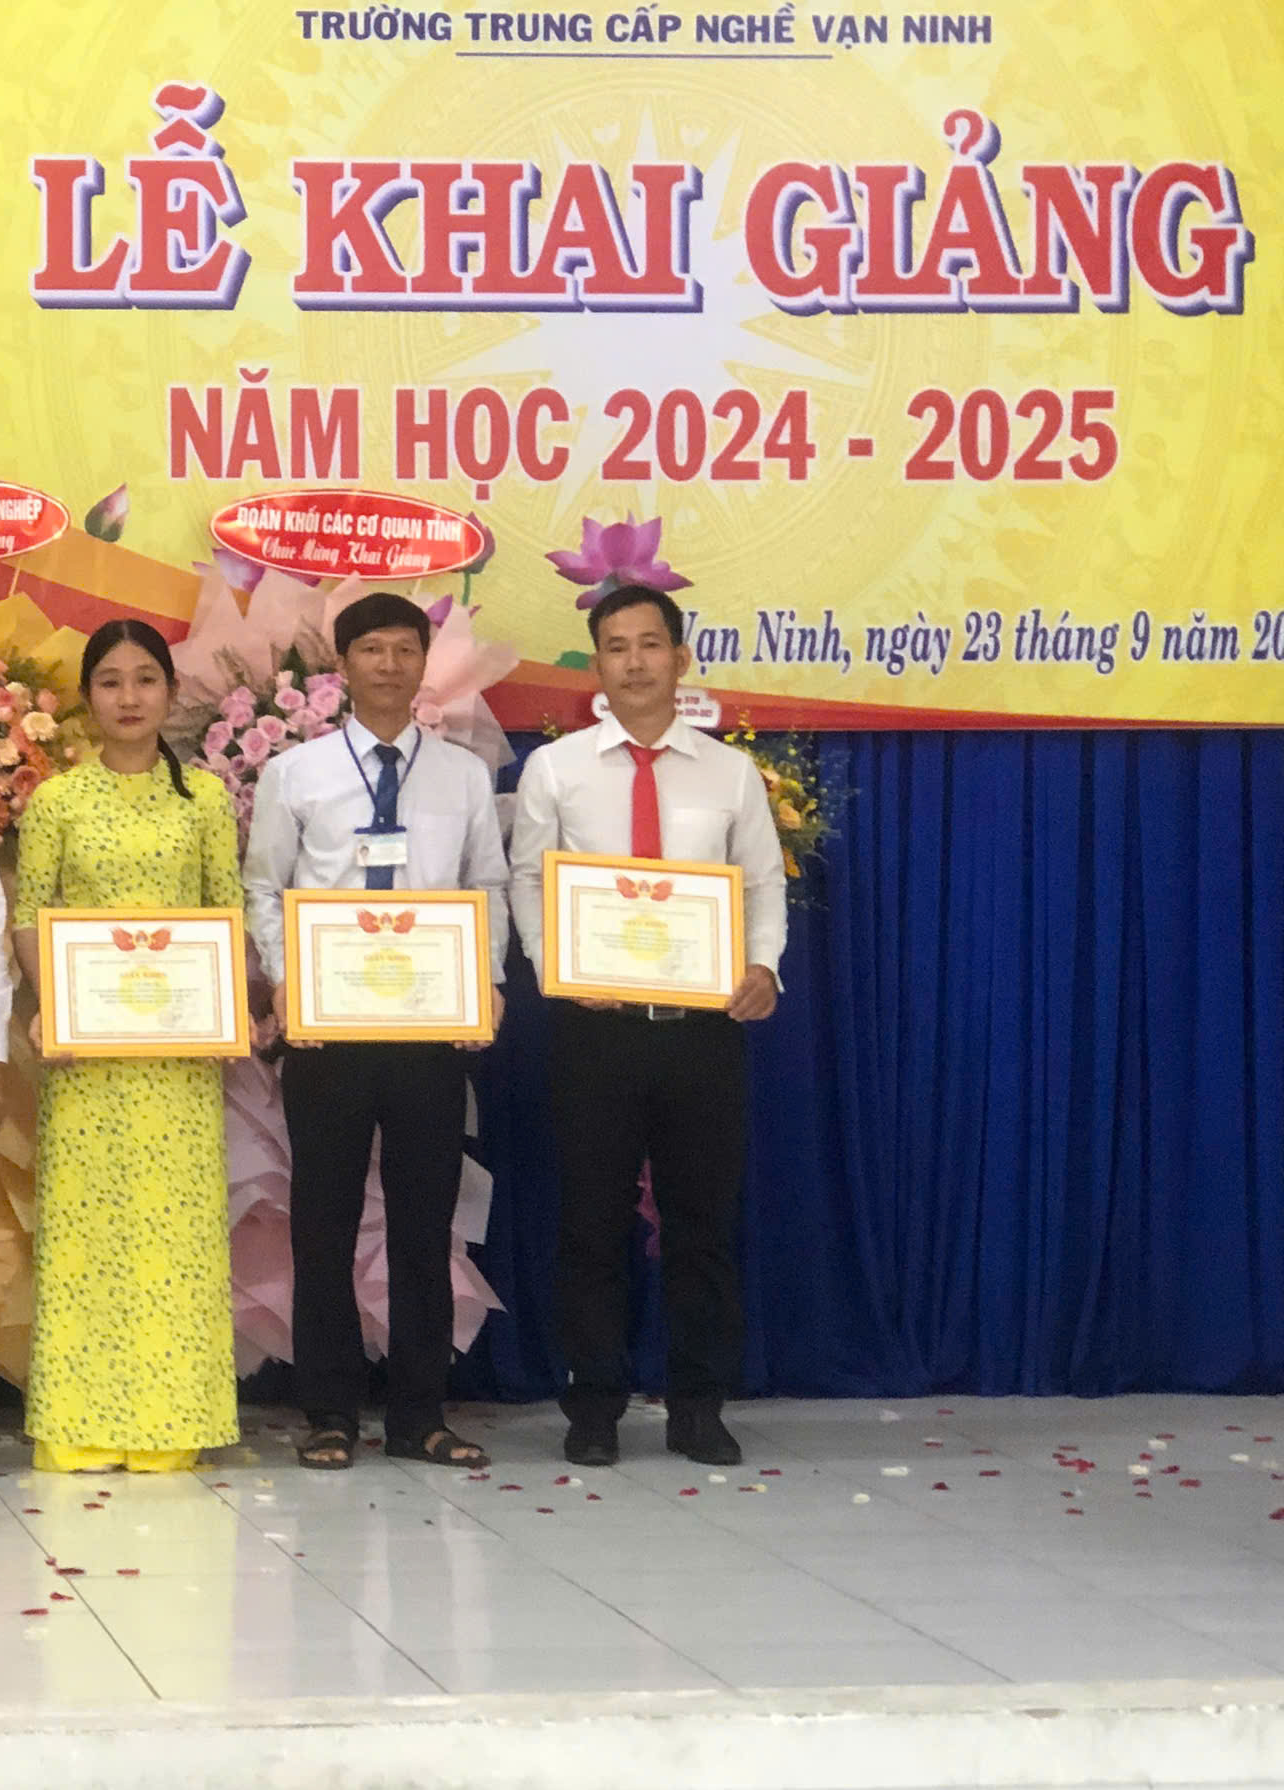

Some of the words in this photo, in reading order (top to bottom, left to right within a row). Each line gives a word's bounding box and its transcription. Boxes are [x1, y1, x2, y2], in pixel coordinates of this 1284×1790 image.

[295, 4, 453, 42] TRƯỜNG
[466, 12, 593, 43] TRUNG
[605, 3, 682, 44] CẤP
[694, 2, 796, 44] NGHỀ
[811, 14, 888, 50] VẠN
[903, 15, 993, 44] NINH
[29, 80, 249, 310] LỄ
[292, 160, 703, 313] KHAI
[743, 107, 1256, 316] GIẢNG
[168, 366, 360, 480] NĂM
[395, 385, 570, 501] HỌC
[601, 387, 817, 482] 2024
[847, 437, 874, 458] -
[904, 387, 1119, 482] 2025
[284, 505, 320, 533] KHỐI
[322, 508, 354, 536] CÁC
[356, 513, 379, 537] CƠ
[380, 516, 422, 540] QUAN
[344, 541, 382, 565] Khai
[752, 609, 852, 674] Ninh,
[866, 610, 952, 676] ngày
[962, 610, 1003, 662] 23
[1015, 608, 1120, 675] tháng
[1130, 610, 1150, 661] 9
[1162, 611, 1241, 661] năm
